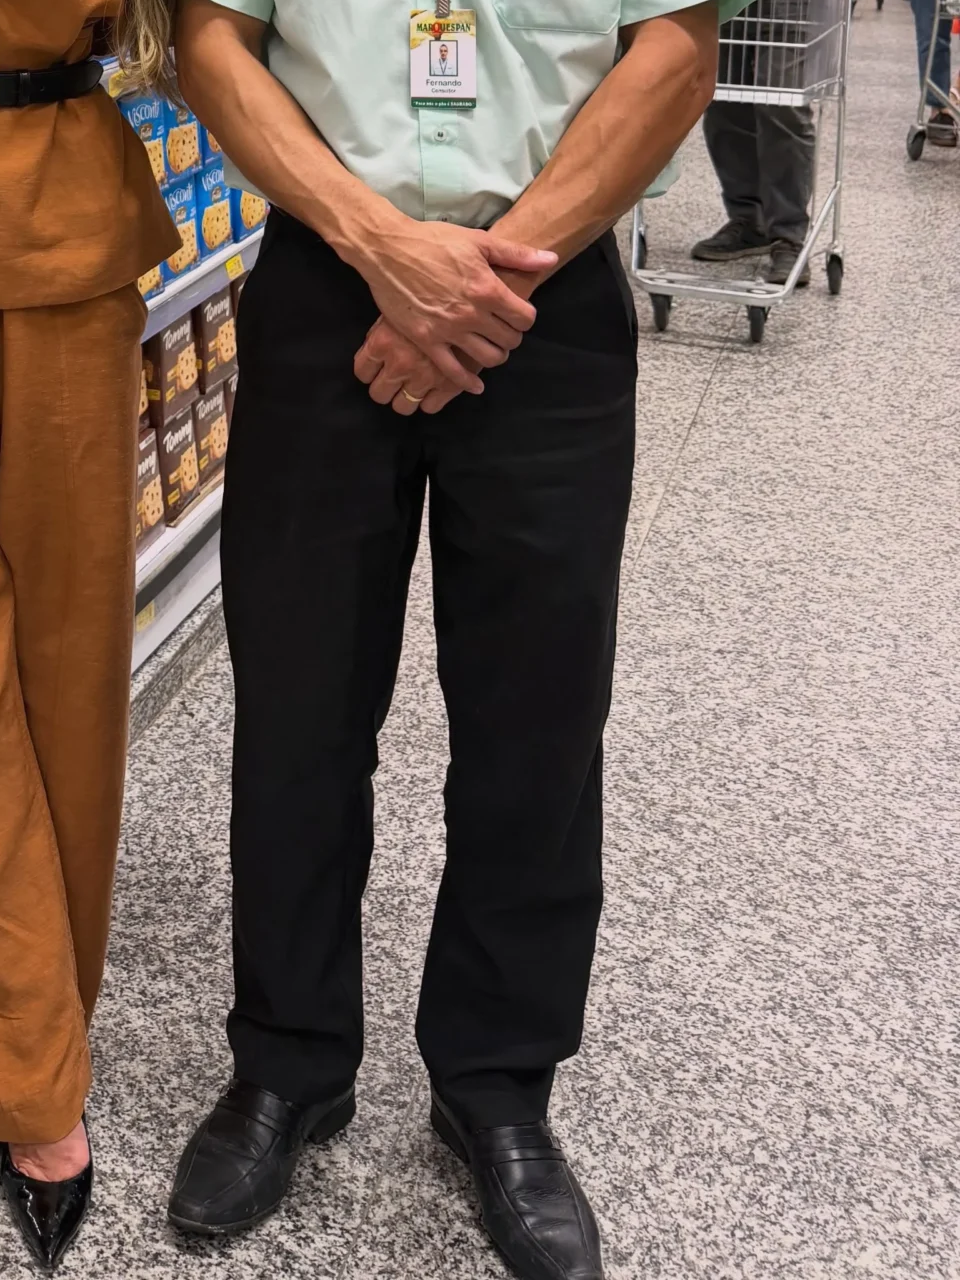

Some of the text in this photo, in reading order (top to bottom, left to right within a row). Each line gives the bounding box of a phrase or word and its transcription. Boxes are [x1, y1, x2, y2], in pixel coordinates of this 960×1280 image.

[416, 22, 471, 33] MARQUESPAN
[426, 79, 462, 87] Fernando
[128, 100, 160, 127] Visconti
[202, 167, 224, 193] Viscon
[204, 294, 230, 323] Tommy
[163, 320, 191, 351] Tommy
[196, 391, 224, 421] Tommy
[163, 420, 192, 455] Tommy
[138, 450, 157, 479] mmy
